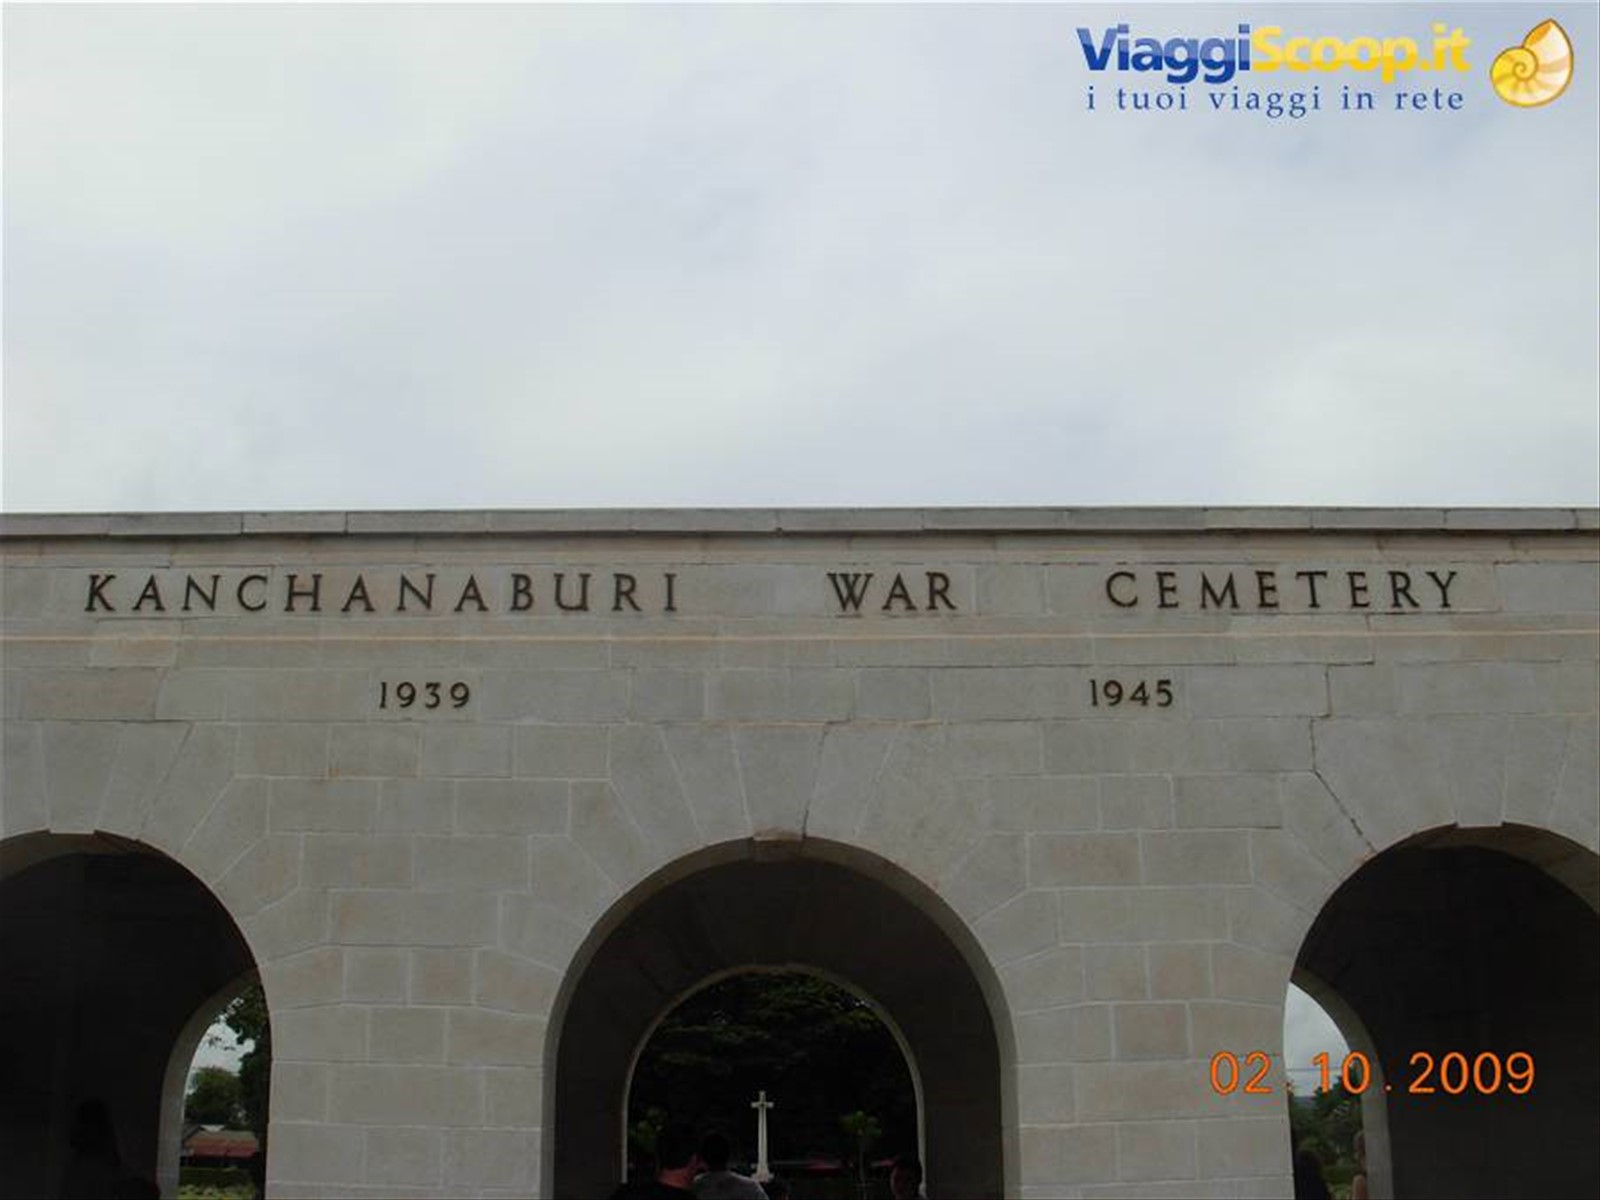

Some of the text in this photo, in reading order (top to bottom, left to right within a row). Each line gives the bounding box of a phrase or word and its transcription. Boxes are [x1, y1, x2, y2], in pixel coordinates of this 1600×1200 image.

[85, 570, 1459, 613] KANCHANABURI WAR CEMETERY
[379, 679, 1175, 709] 1939 1945
